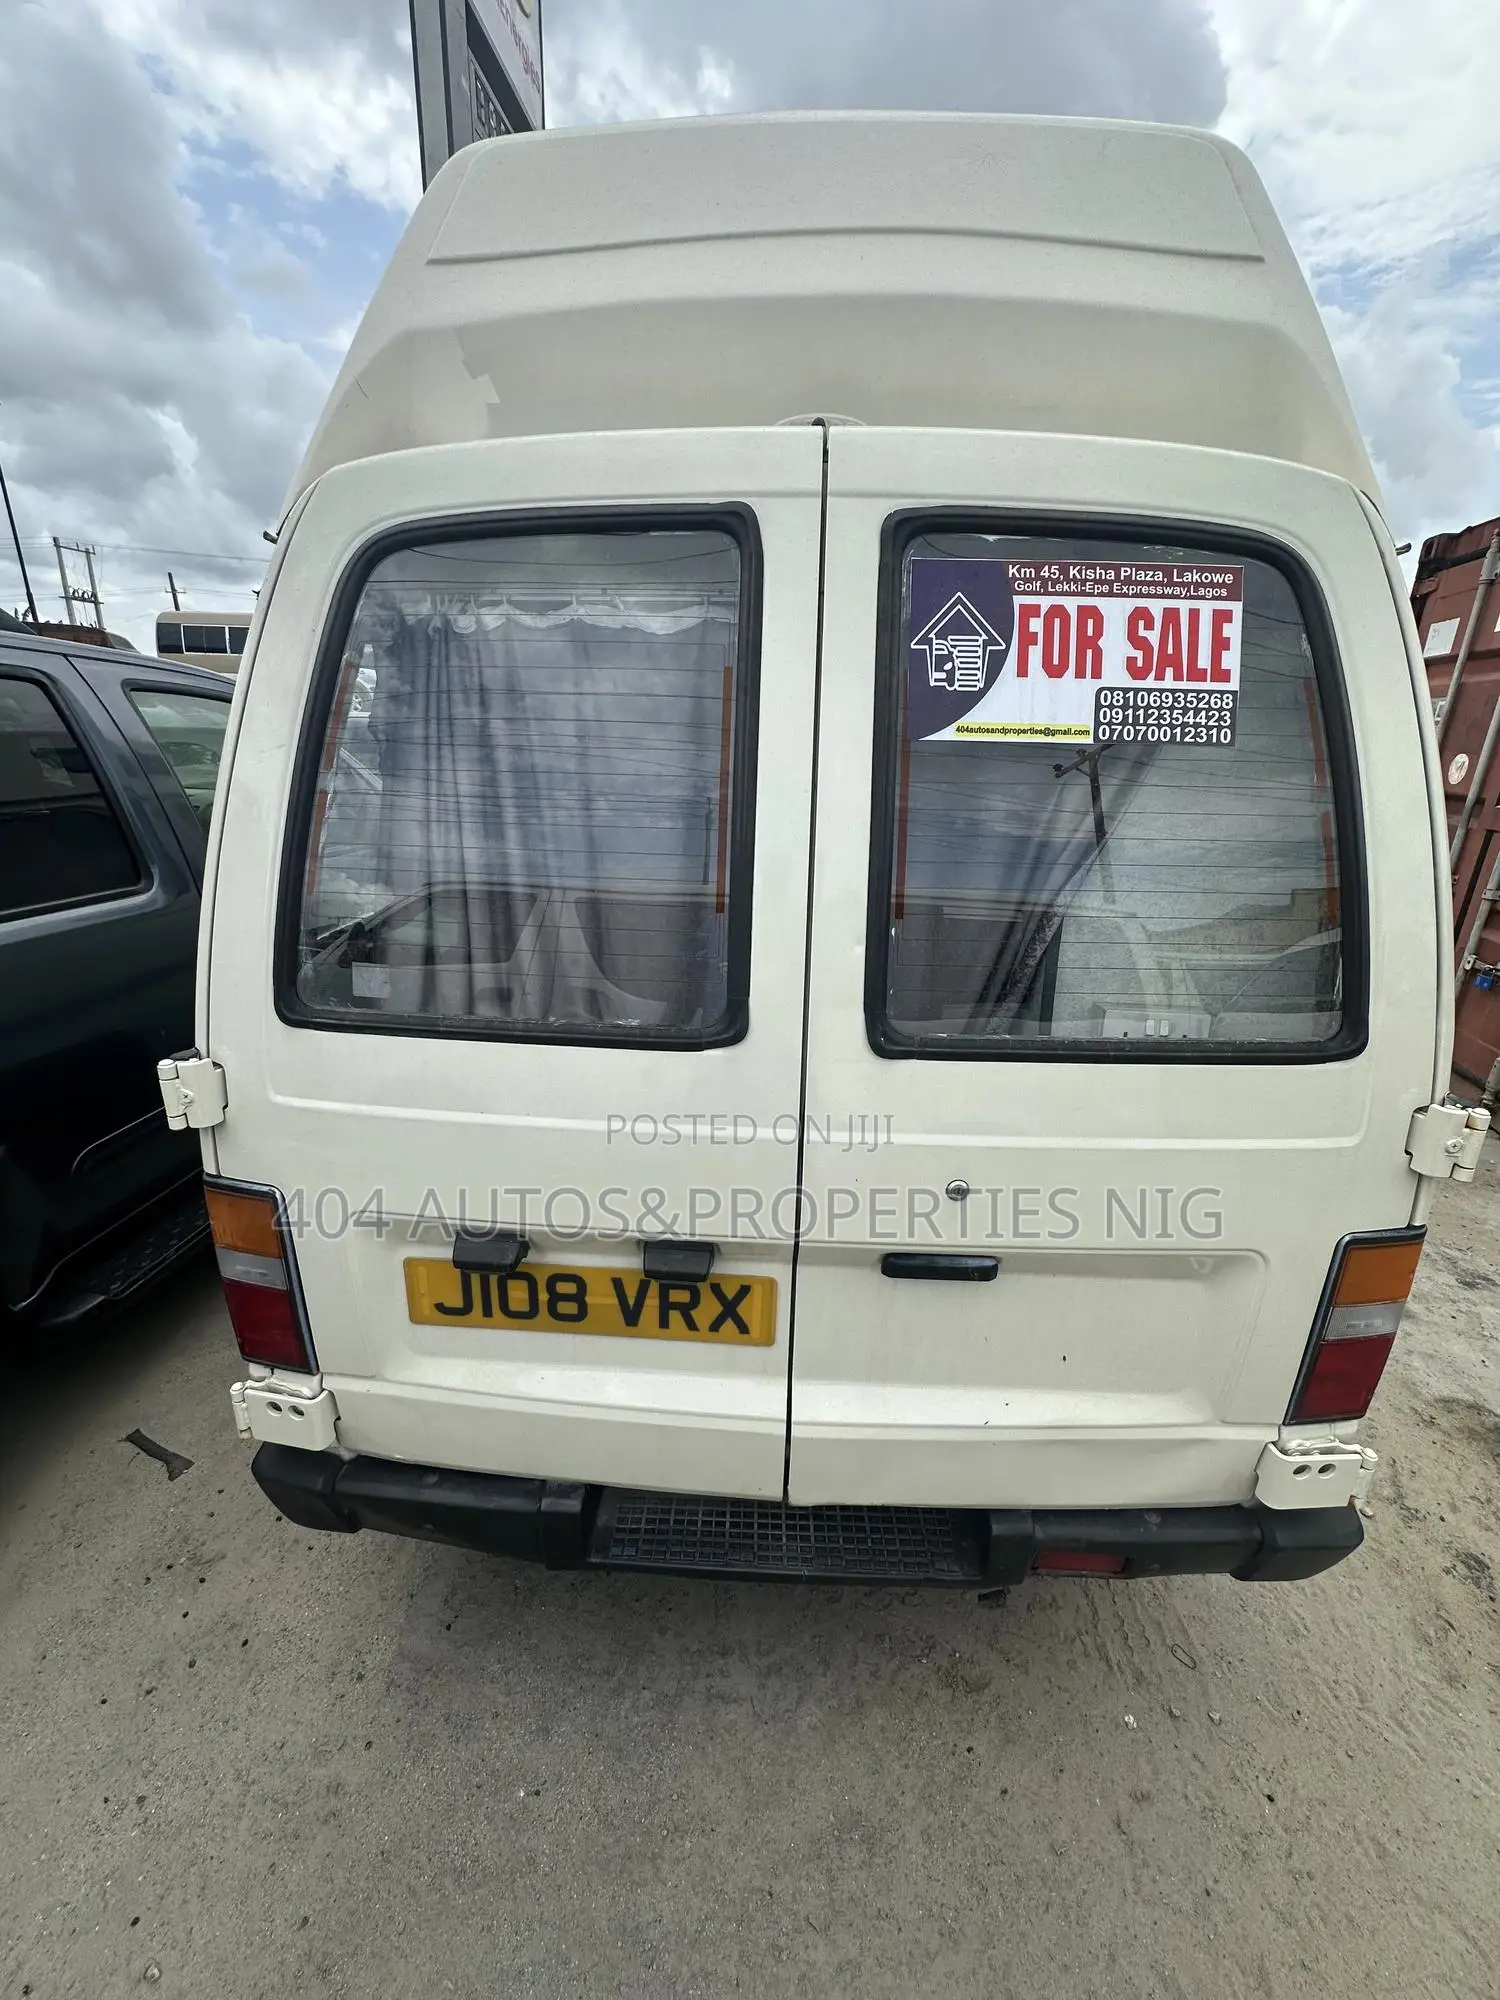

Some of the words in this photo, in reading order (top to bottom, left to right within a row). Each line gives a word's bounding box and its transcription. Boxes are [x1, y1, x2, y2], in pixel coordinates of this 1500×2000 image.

[1008, 565, 1035, 578] Km
[1040, 566, 1064, 581] 45,
[1069, 566, 1115, 581] Kisha
[1120, 567, 1168, 584] Plaza,
[1173, 569, 1234, 584] Lakowe
[1014, 580, 1045, 593] Golf,
[1048, 581, 1110, 596] Lekki-Epe
[1016, 603, 1105, 680] FOR
[1125, 606, 1234, 683] SALE
[1100, 690, 1234, 709] 08106935268
[1099, 707, 1232, 727] 09112354423
[955, 725, 1091, 738] 404autosandproperties@gmail.com
[1098, 724, 1232, 744] 07070012310
[433, 1270, 589, 1322] J108
[610, 1276, 752, 1335] VRX
